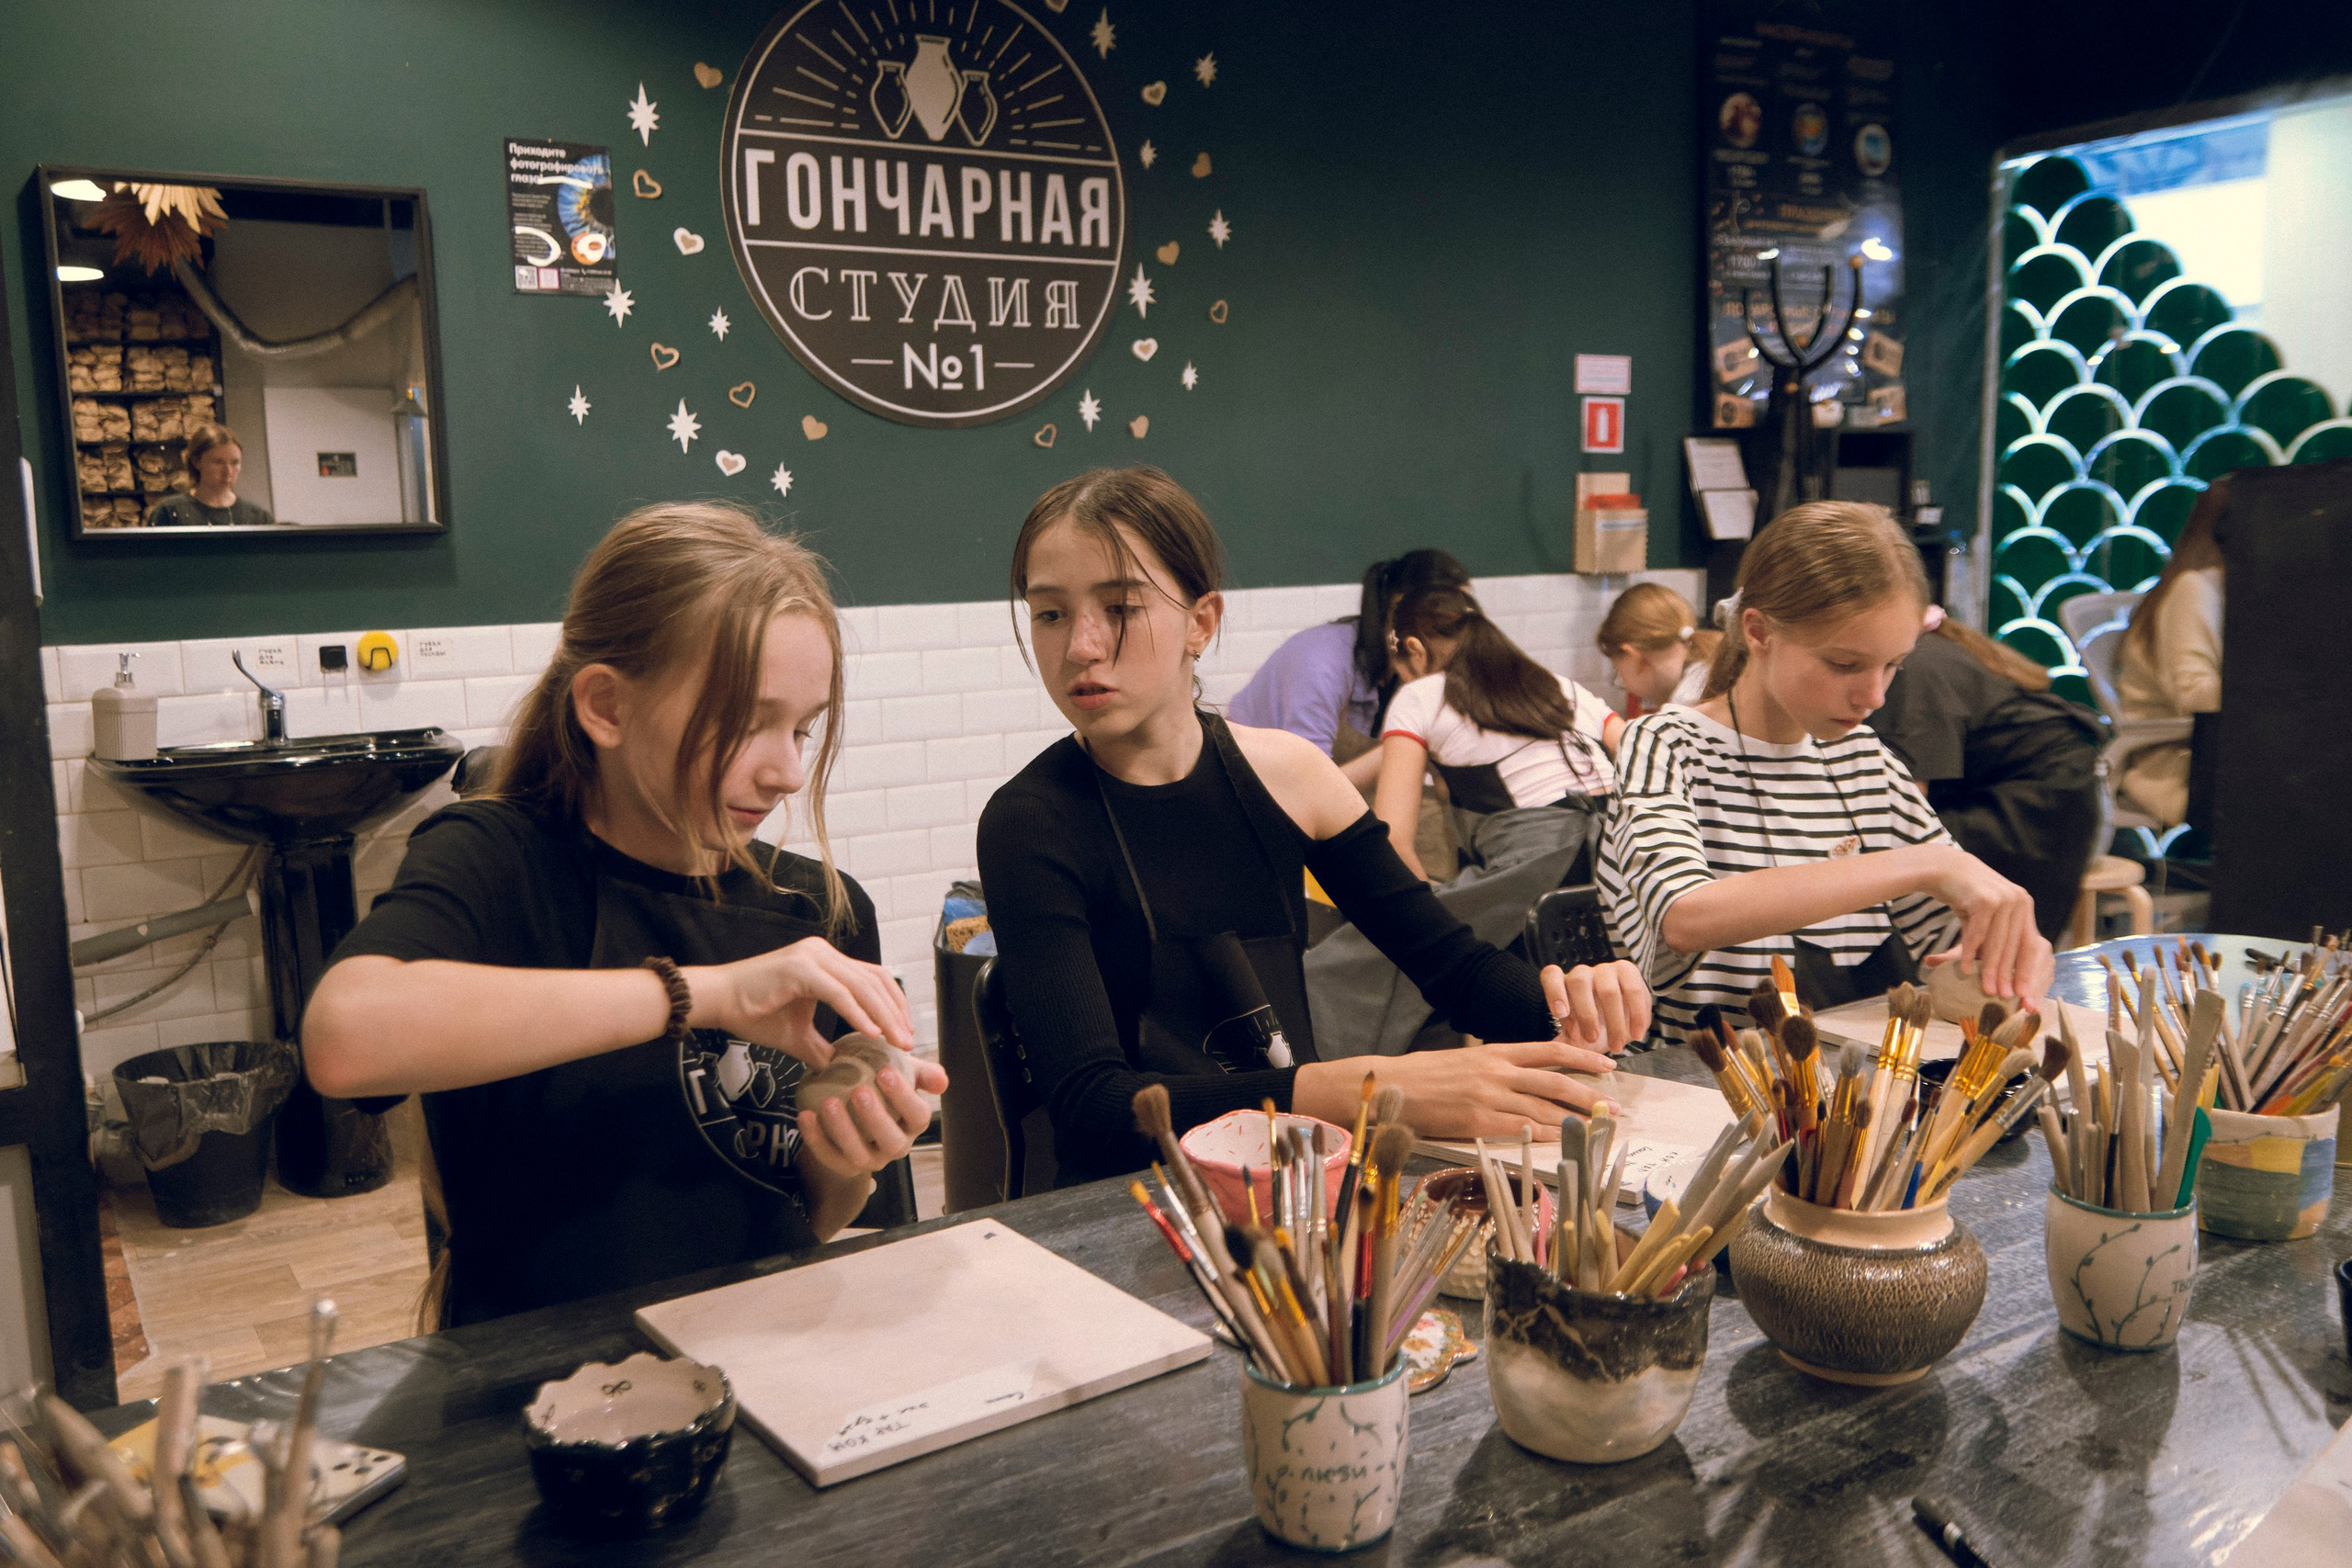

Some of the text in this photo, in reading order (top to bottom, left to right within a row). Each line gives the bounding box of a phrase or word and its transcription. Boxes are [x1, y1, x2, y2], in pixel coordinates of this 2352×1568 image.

[509, 142, 567, 159] Приходите
[510, 157, 605, 175] фотографировать
[745, 148, 1110, 248] ГОНЧАРНАЯ
[789, 266, 1081, 333] СТУДИЯ
